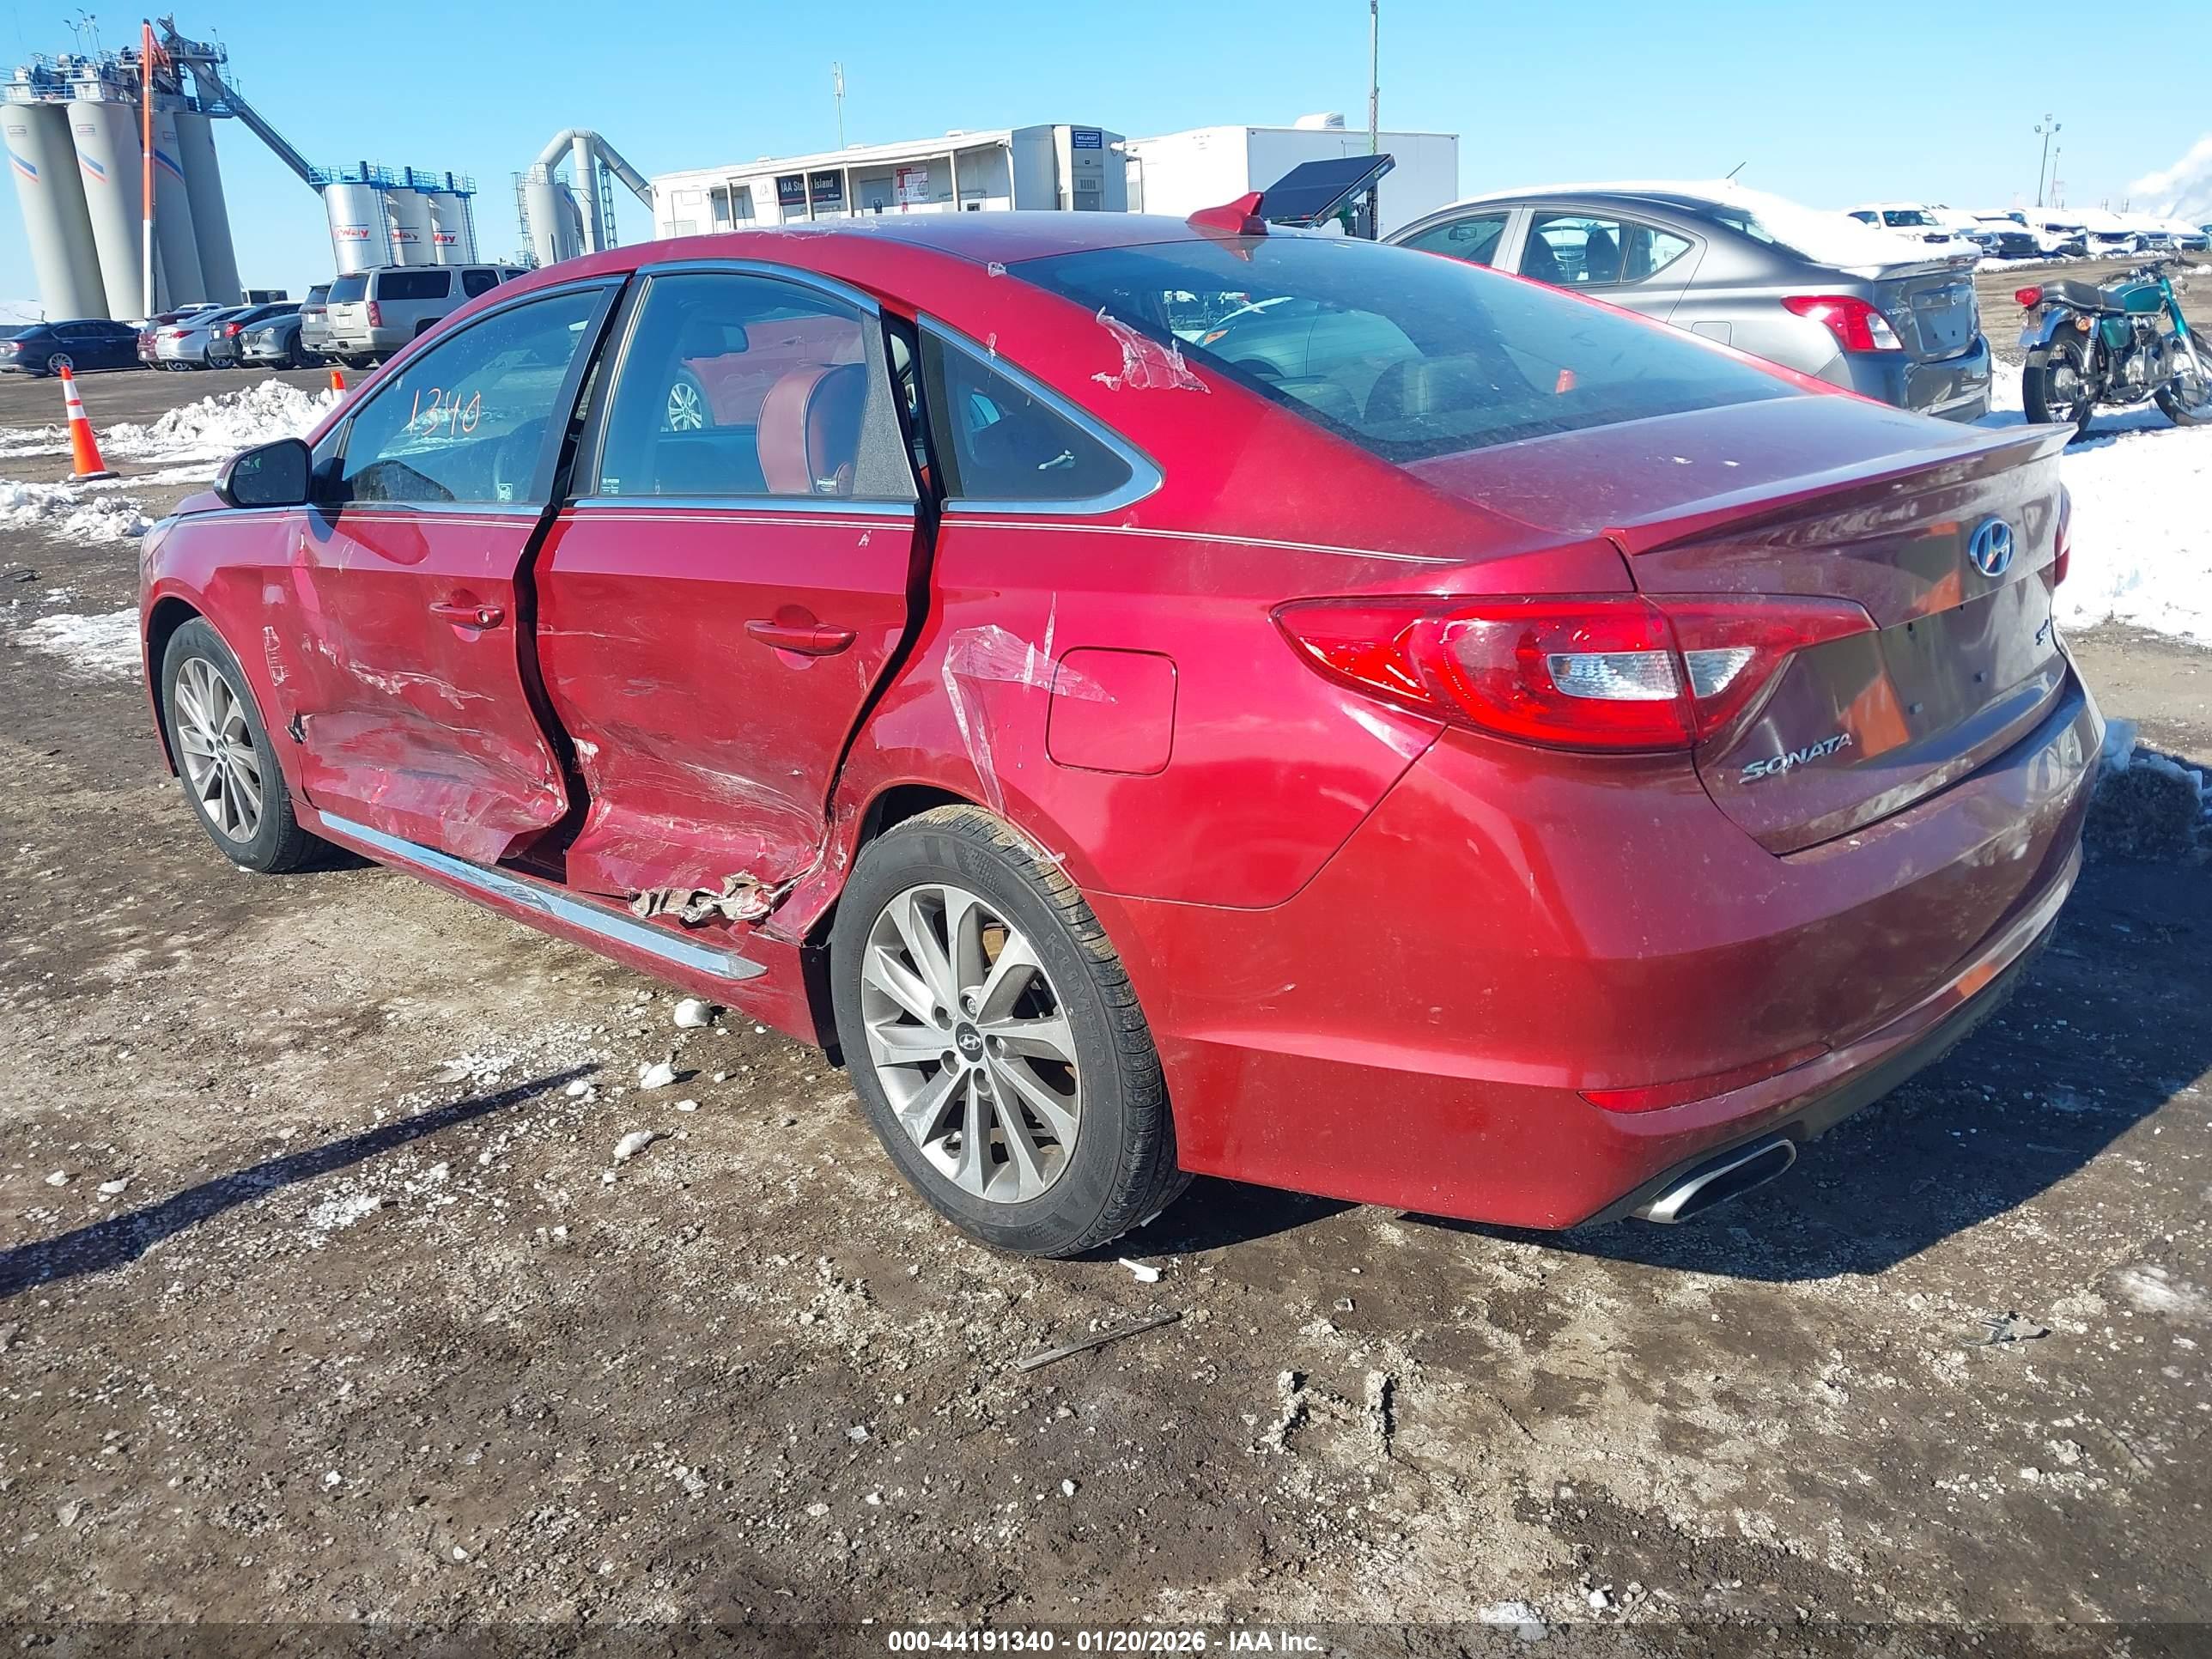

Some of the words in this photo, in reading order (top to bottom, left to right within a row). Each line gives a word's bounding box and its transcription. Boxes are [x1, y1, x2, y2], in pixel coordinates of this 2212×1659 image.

[781, 181, 793, 193] IAA
[814, 177, 834, 189] Island
[410, 387, 481, 436] 1340
[1738, 732, 1853, 785] SONATA
